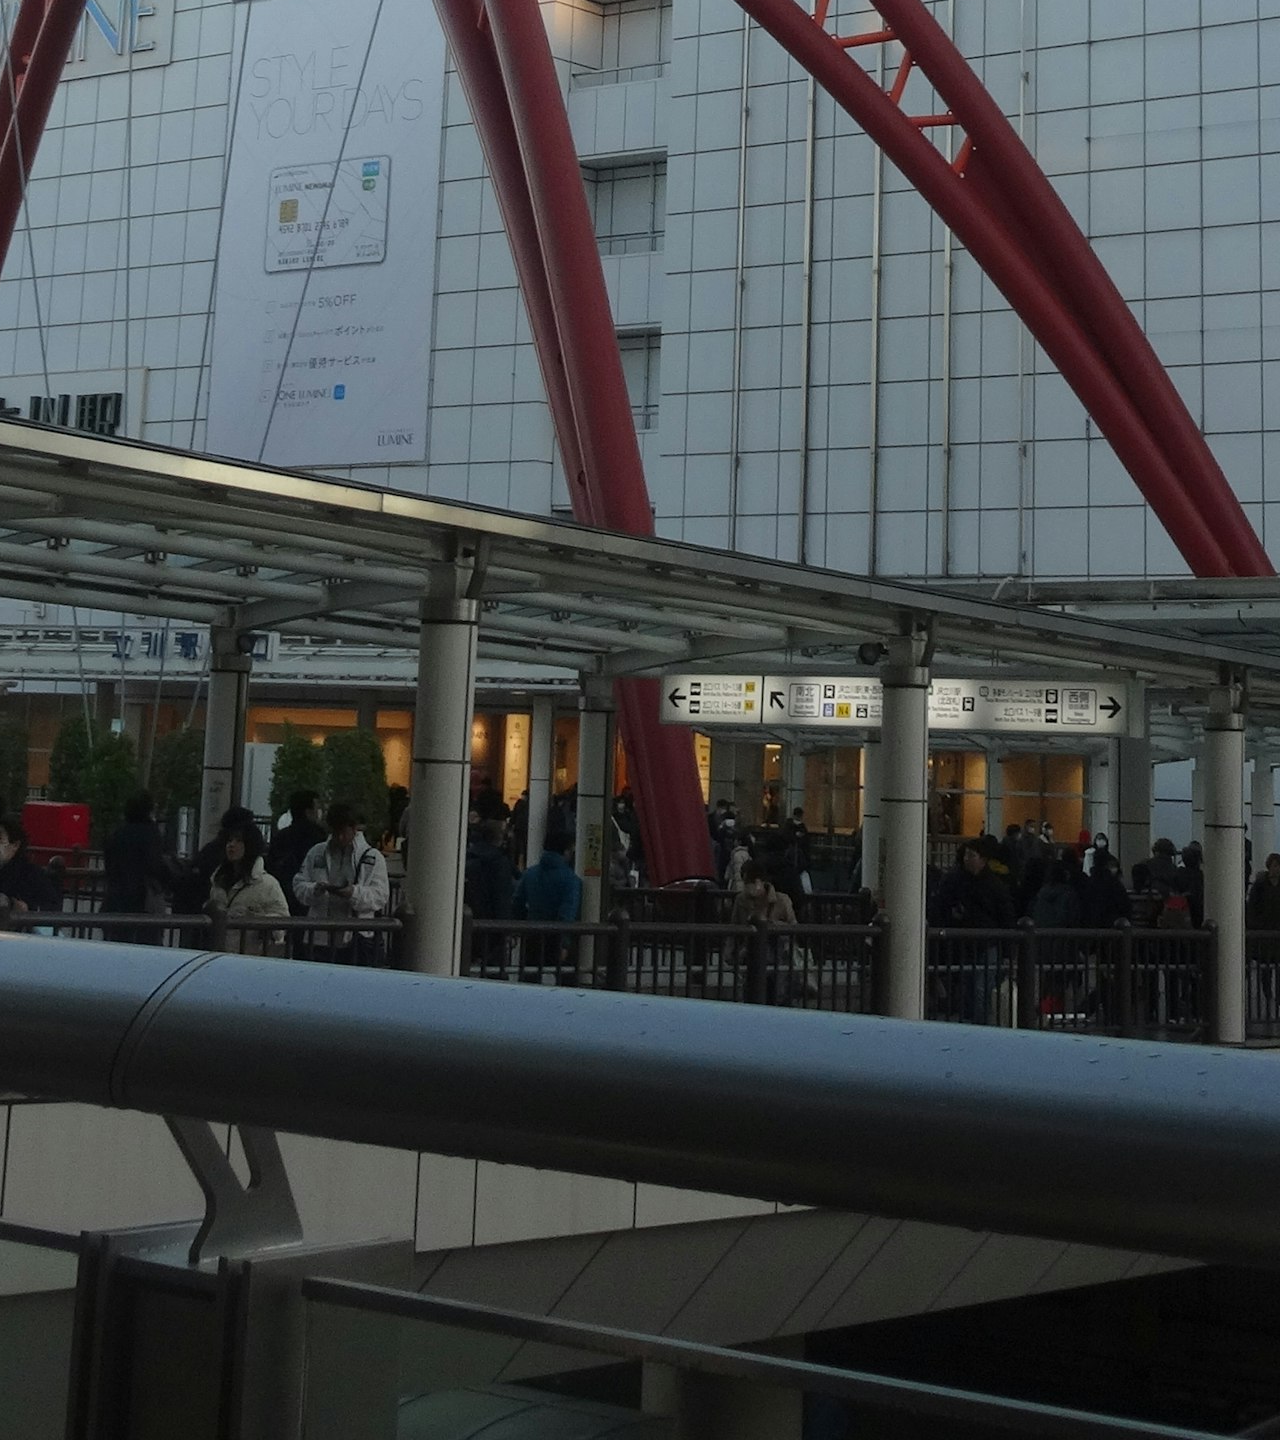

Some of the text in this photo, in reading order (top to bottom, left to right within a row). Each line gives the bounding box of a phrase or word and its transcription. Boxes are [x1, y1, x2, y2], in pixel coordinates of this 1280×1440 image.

[250, 45, 350, 99] STYLE
[248, 78, 424, 140] YOUR DAYS
[318, 293, 357, 309] 5%OFF
